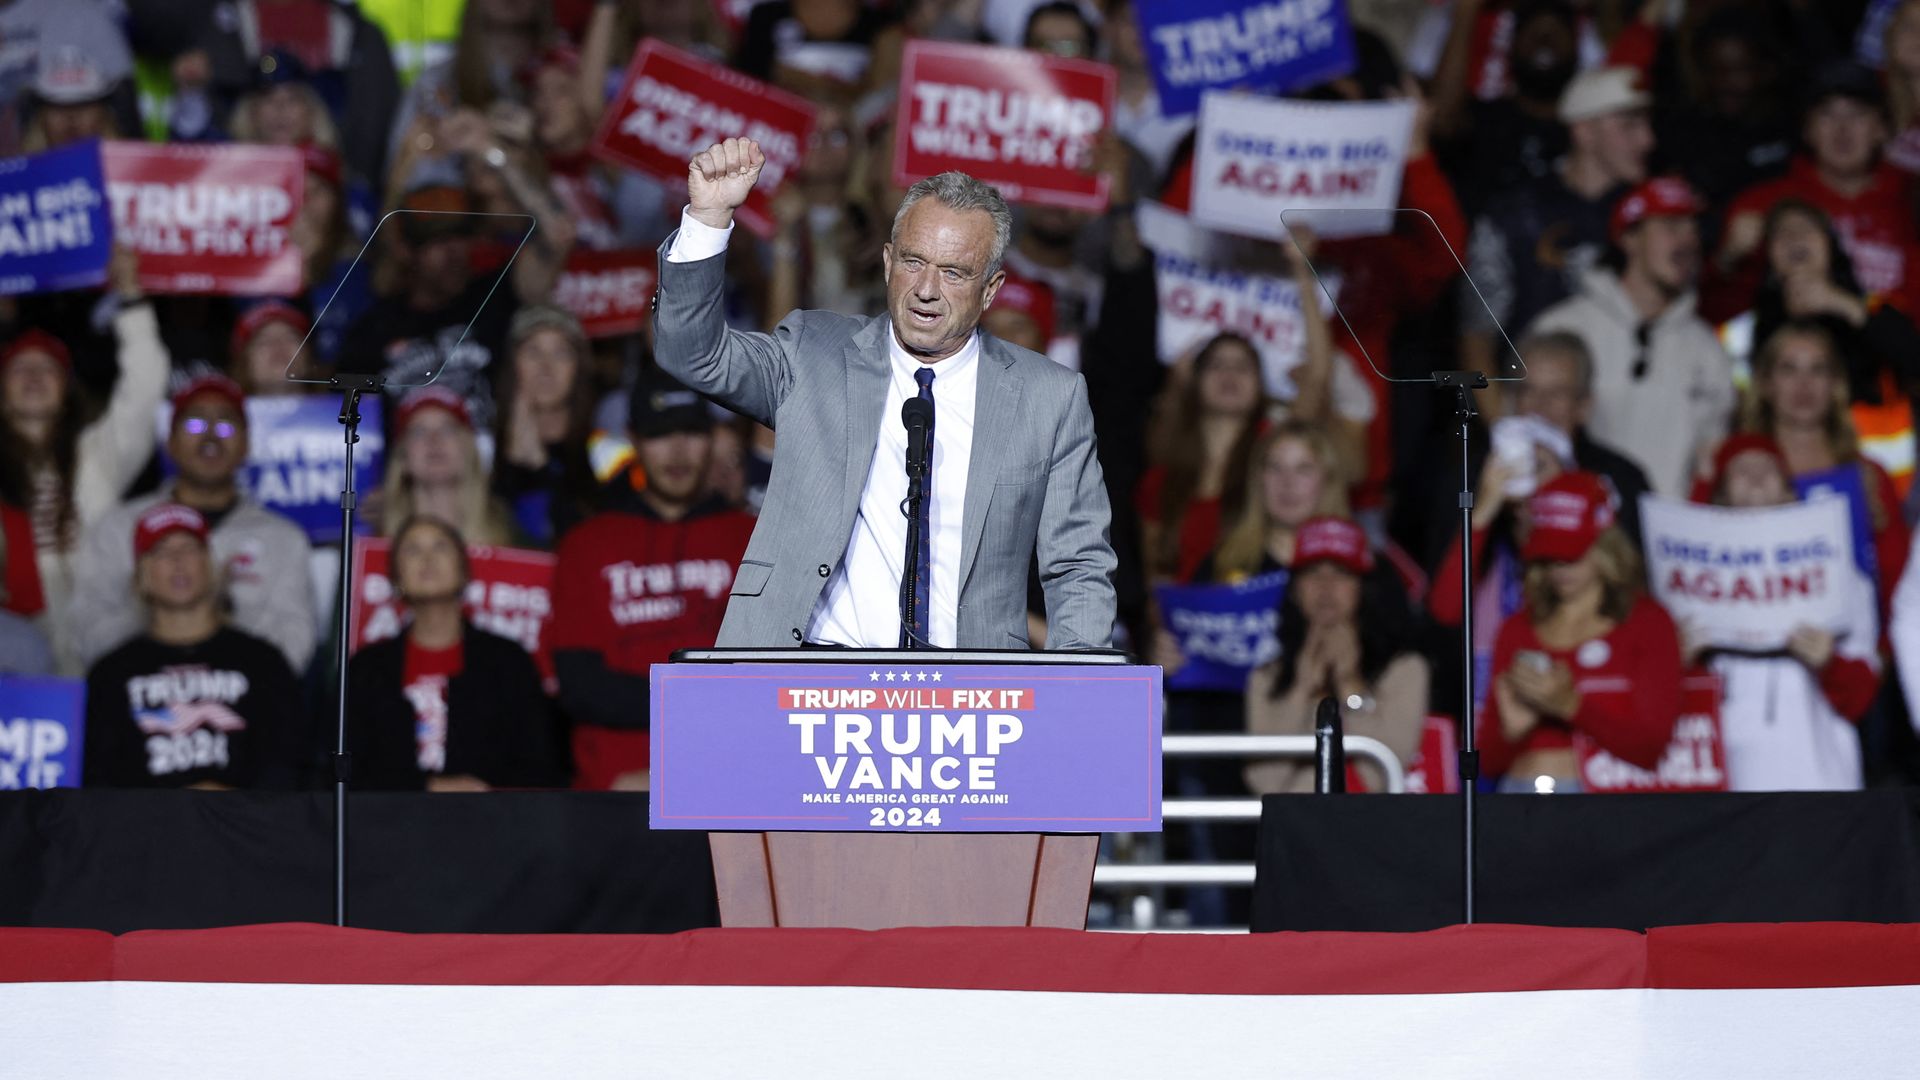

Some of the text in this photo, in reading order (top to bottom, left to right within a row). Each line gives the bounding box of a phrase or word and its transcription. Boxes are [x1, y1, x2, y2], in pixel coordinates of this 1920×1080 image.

[633, 76, 746, 144] DREAM
[914, 82, 1103, 137] TRUMP
[911, 125, 996, 162] WILL
[1002, 138, 1057, 167] FIX
[1214, 132, 1328, 160] DREAM
[1219, 161, 1377, 197] AGAIN!
[108, 182, 291, 232] TRUMP
[1659, 537, 1764, 566] DREAM
[1668, 567, 1826, 605] AGAIN!
[127, 669, 250, 712] TRUMP
[789, 690, 1023, 708] TRUMP WILL FIX IT
[789, 714, 1023, 754] TRUMP
[815, 757, 995, 790] VANCE
[803, 794, 1008, 803] MAKE AMERICA GREAT AGAIN!
[870, 808, 941, 826] 2024
